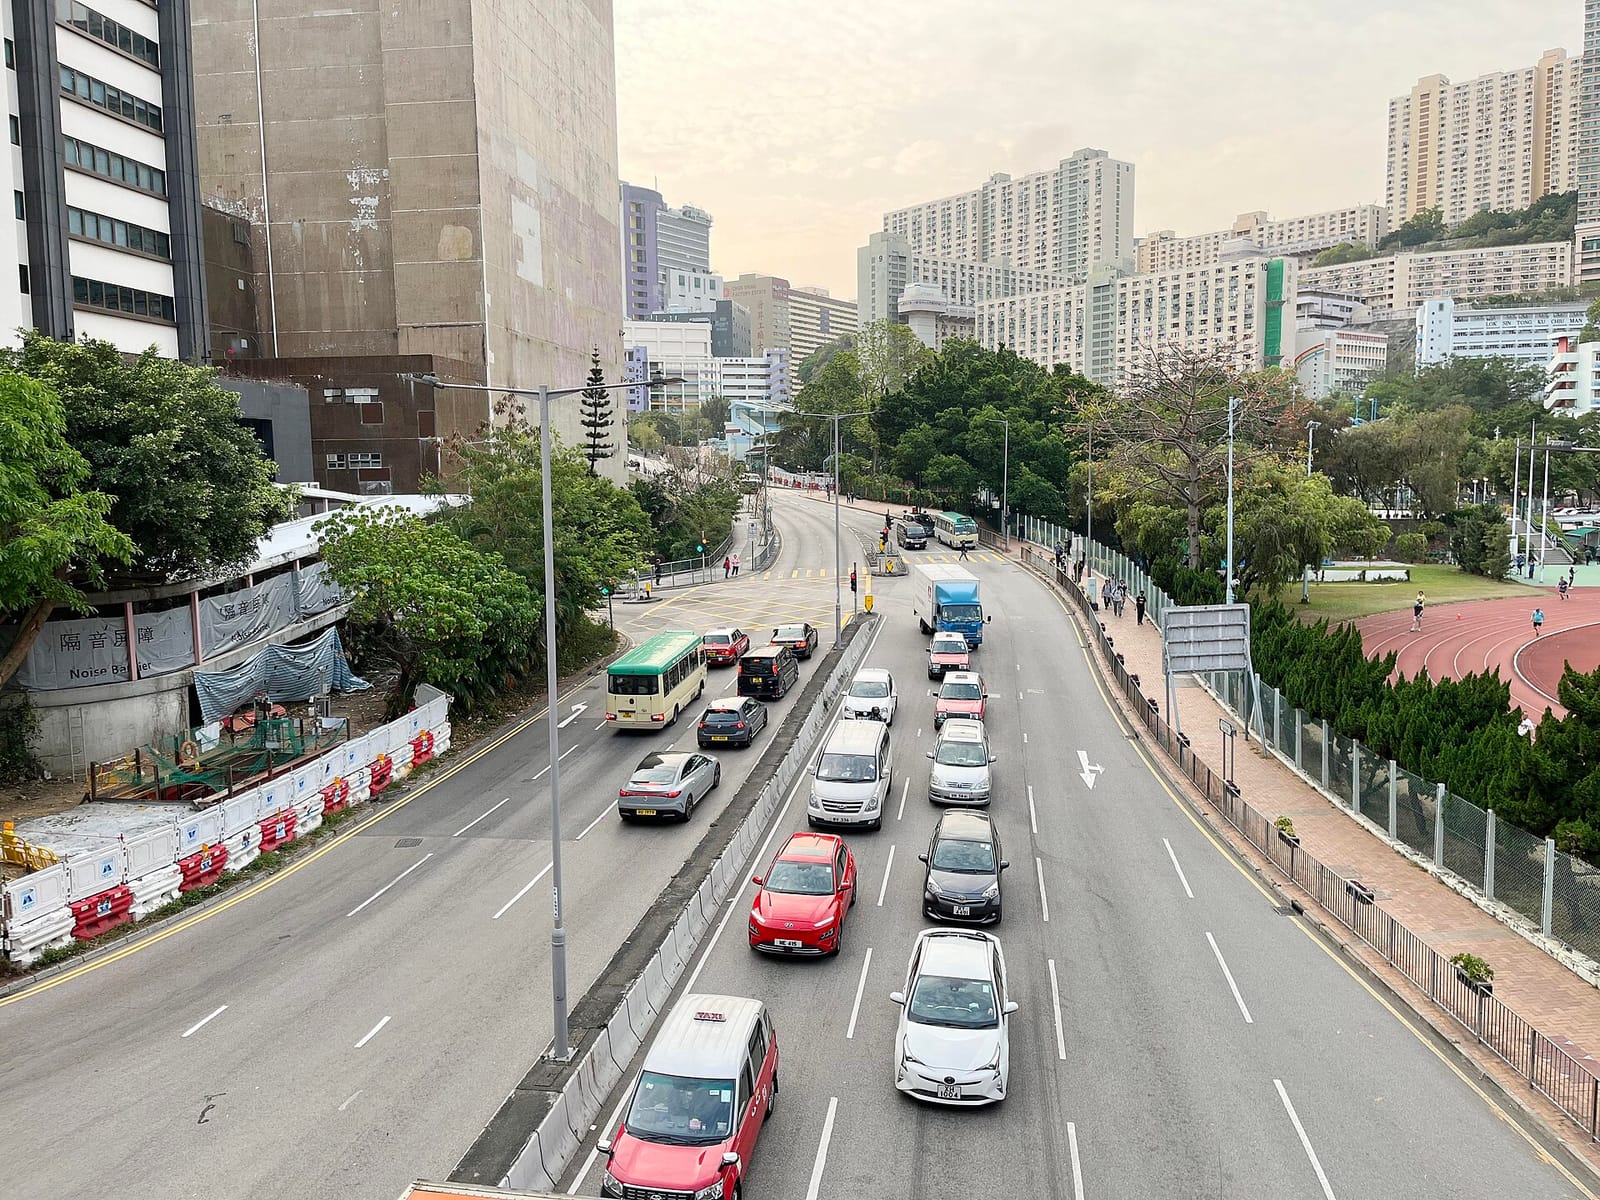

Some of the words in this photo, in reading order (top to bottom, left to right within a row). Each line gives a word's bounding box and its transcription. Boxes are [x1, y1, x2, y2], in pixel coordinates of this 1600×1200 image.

[878, 255, 883, 263] 9
[1261, 262, 1269, 271] 10
[70, 667, 107, 679] Noise
[111, 661, 152, 675] Baier
[696, 1011, 723, 1020] TAXI
[944, 1084, 955, 1092] XH
[940, 1090, 958, 1098] 1004
